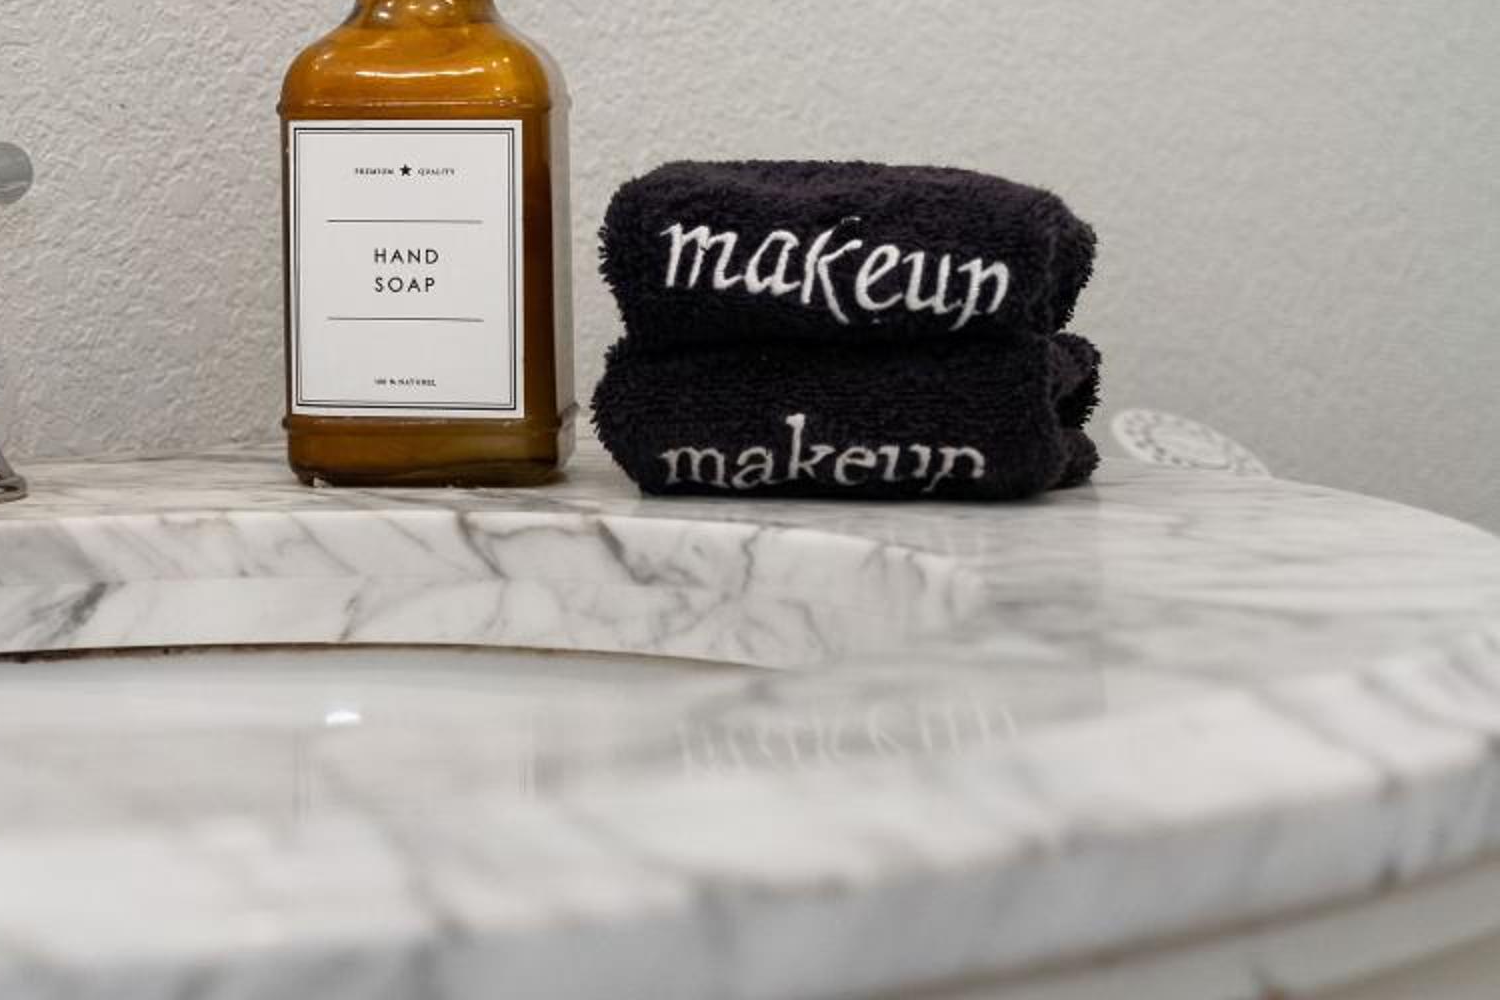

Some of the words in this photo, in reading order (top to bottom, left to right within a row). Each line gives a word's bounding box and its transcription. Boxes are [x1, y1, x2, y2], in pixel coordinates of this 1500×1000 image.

[418, 167, 455, 177] QUALITY
[374, 248, 439, 264] HAND
[375, 277, 435, 293] SOAP
